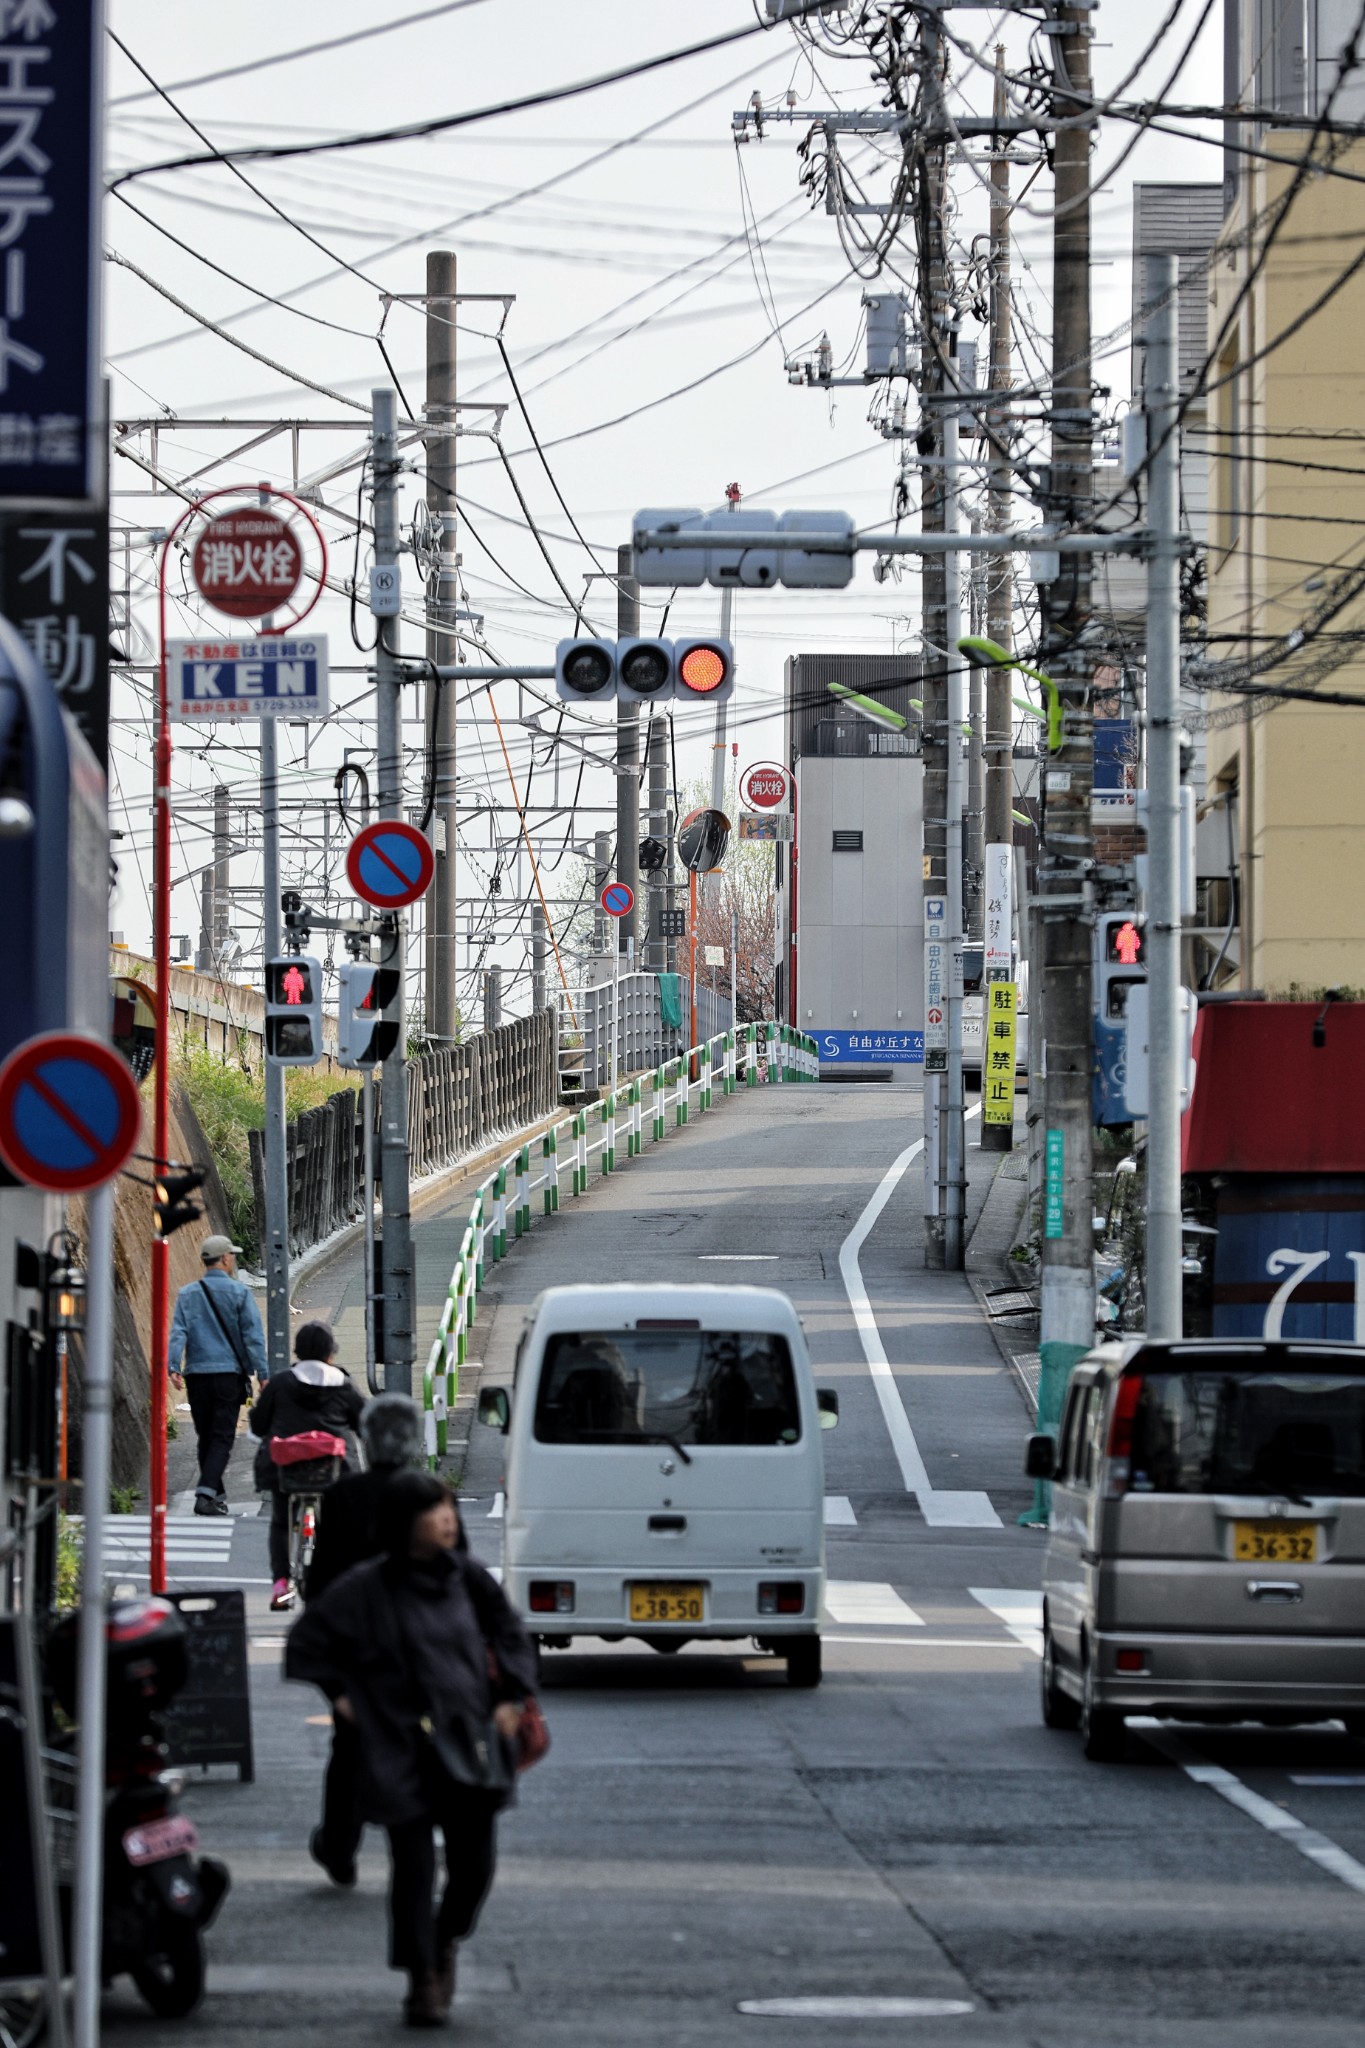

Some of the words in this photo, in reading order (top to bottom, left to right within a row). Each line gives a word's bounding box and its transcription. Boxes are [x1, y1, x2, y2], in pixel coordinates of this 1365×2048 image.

[209, 520, 232, 536] FIRE
[236, 520, 285, 536] HYDRANT
[202, 540, 296, 586] 消火栓
[17, 527, 97, 738] 不動
[182, 641, 317, 659] 不動産は信頼の
[193, 661, 306, 698] KEN
[751, 780, 783, 796] 消火栓
[928, 924, 941, 1008] 自由が丘歯科
[991, 990, 1013, 1100] 駐車禁止
[1049, 1208, 1061, 1219] 29
[1253, 1536, 1313, 1559] 36-32
[647, 1599, 700, 1618] 38-50
